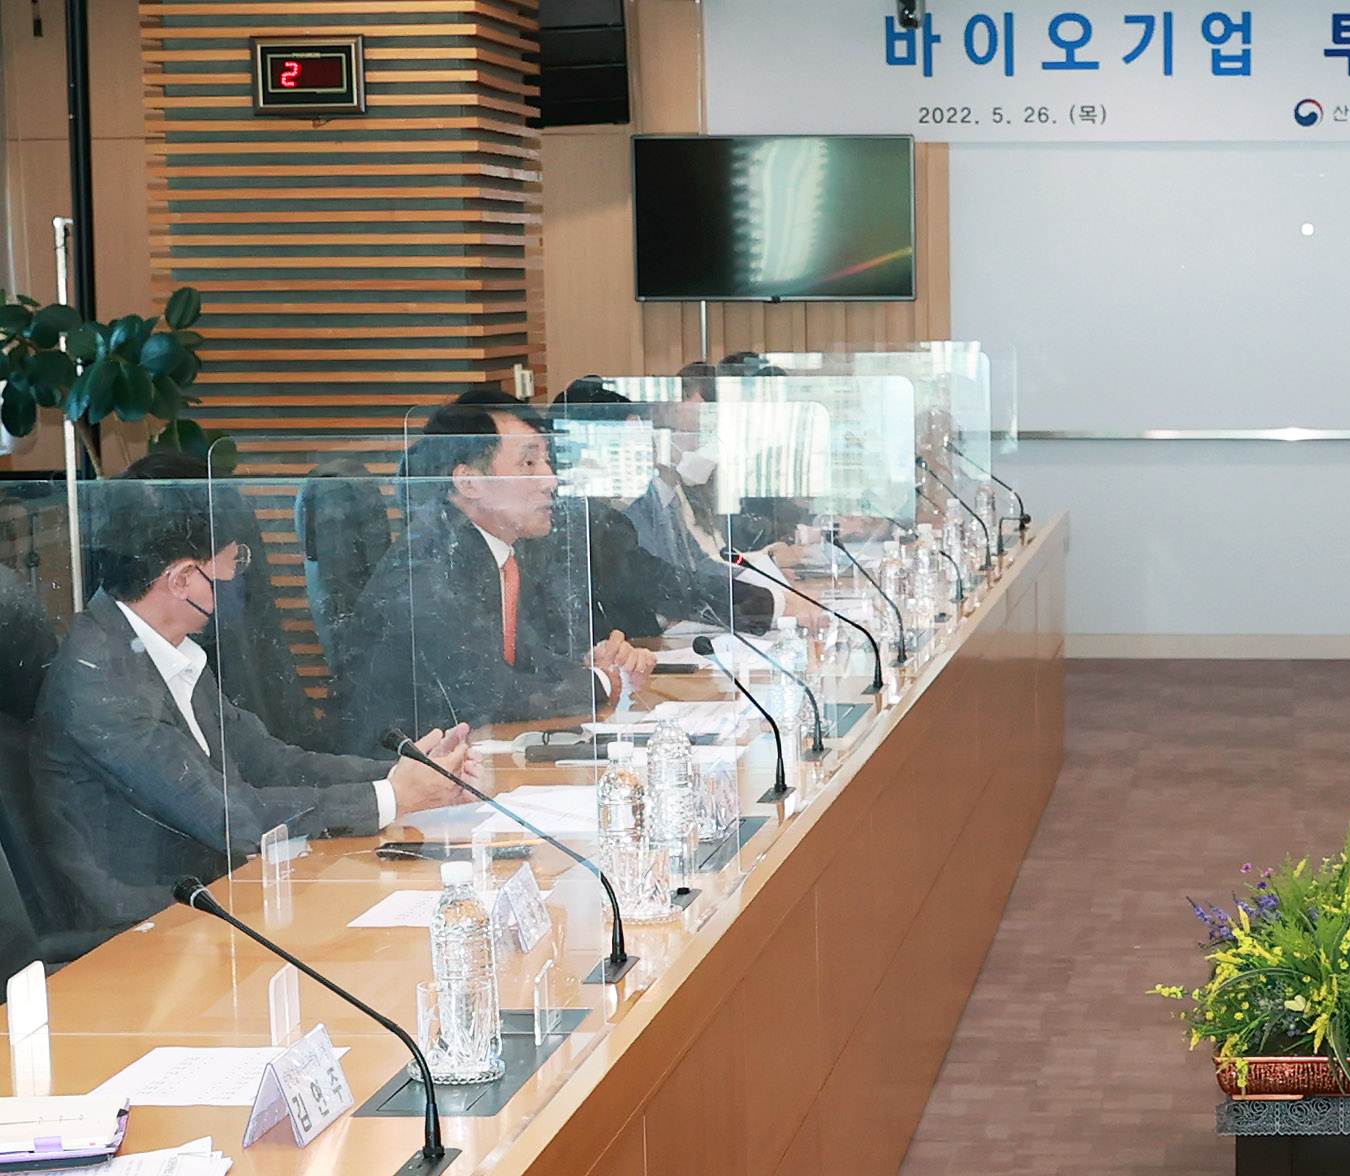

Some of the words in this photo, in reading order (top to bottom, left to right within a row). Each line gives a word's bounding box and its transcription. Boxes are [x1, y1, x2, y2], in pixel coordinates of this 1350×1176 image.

[883, 10, 1252, 78] 바이오기업
[280, 61, 302, 87] 2
[918, 106, 980, 124] 2022.
[992, 106, 1012, 124] 5.
[1023, 106, 1057, 124] 26.
[1069, 104, 1107, 125] (목)
